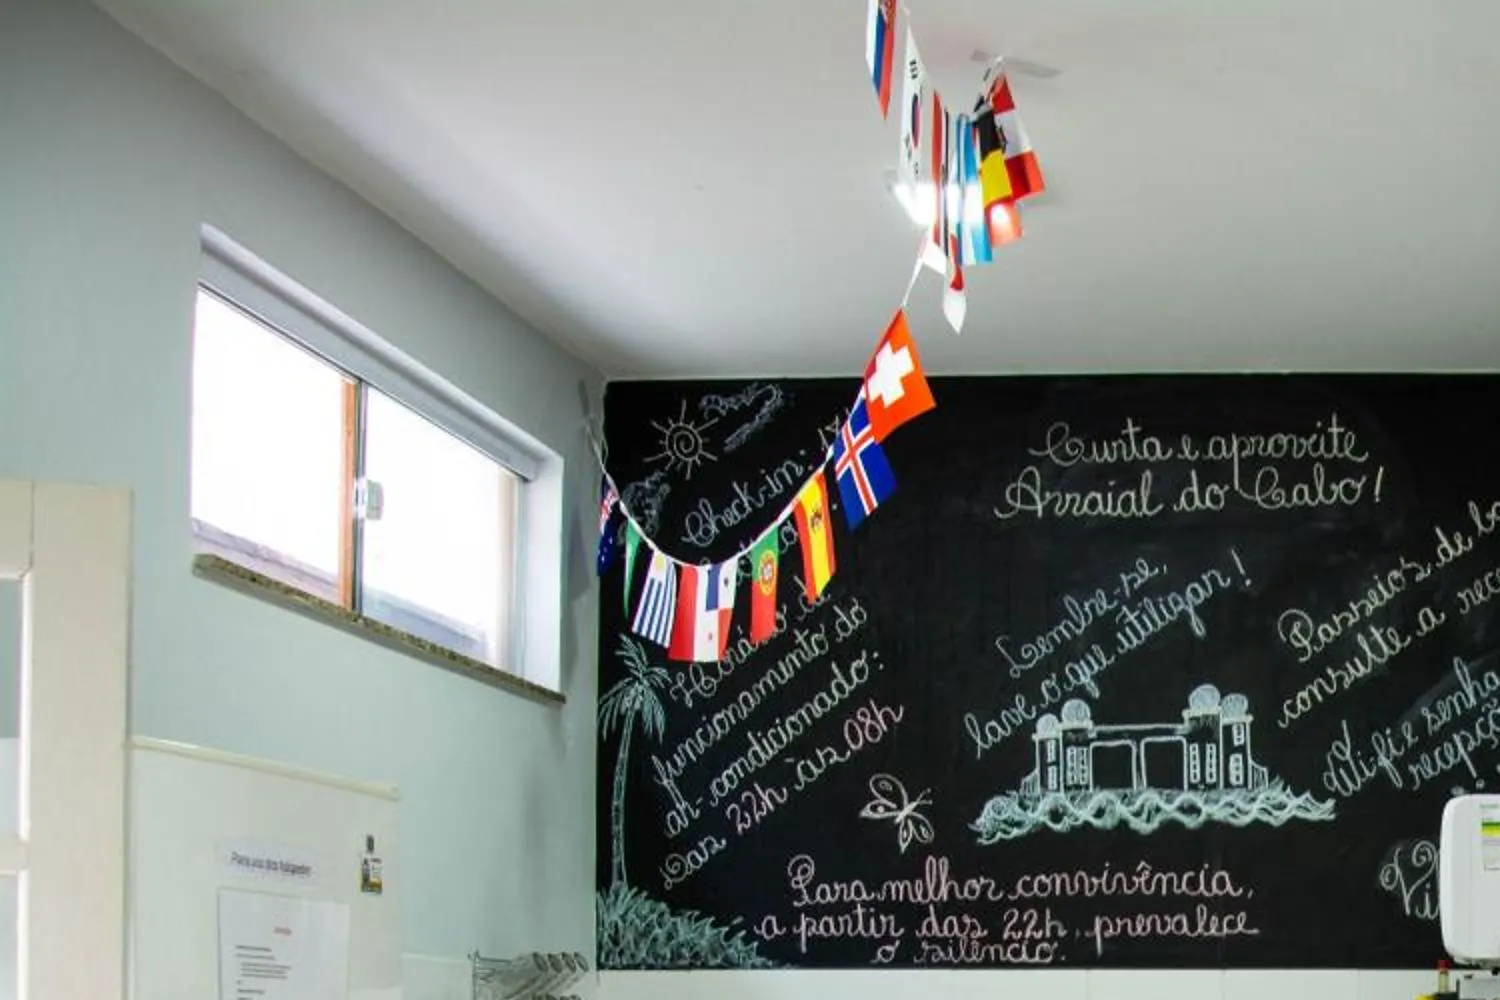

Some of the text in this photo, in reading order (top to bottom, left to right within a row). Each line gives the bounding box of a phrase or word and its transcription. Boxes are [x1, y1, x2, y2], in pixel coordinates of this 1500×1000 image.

[1028, 412, 1369, 489] Curta e aproveite
[994, 462, 1384, 518] Arraial do Cabo!
[1278, 556, 1431, 662] Passeios
[1436, 526, 1474, 568] de
[652, 597, 867, 806] funcionamento do
[964, 694, 1037, 759] lave
[1040, 672, 1062, 708] o
[1063, 643, 1116, 699] que
[1278, 624, 1412, 729] consulte
[1416, 606, 1446, 637] a
[1403, 721, 1419, 748] e
[659, 835, 727, 890] Das
[725, 783, 788, 836] 22h
[843, 699, 904, 753] 08h
[787, 854, 1253, 907] Para melhor convivência,
[753, 914, 787, 940] a
[793, 903, 905, 954] partir
[915, 904, 988, 938] das
[1084, 903, 1260, 955] prevalece
[870, 939, 900, 964] o
